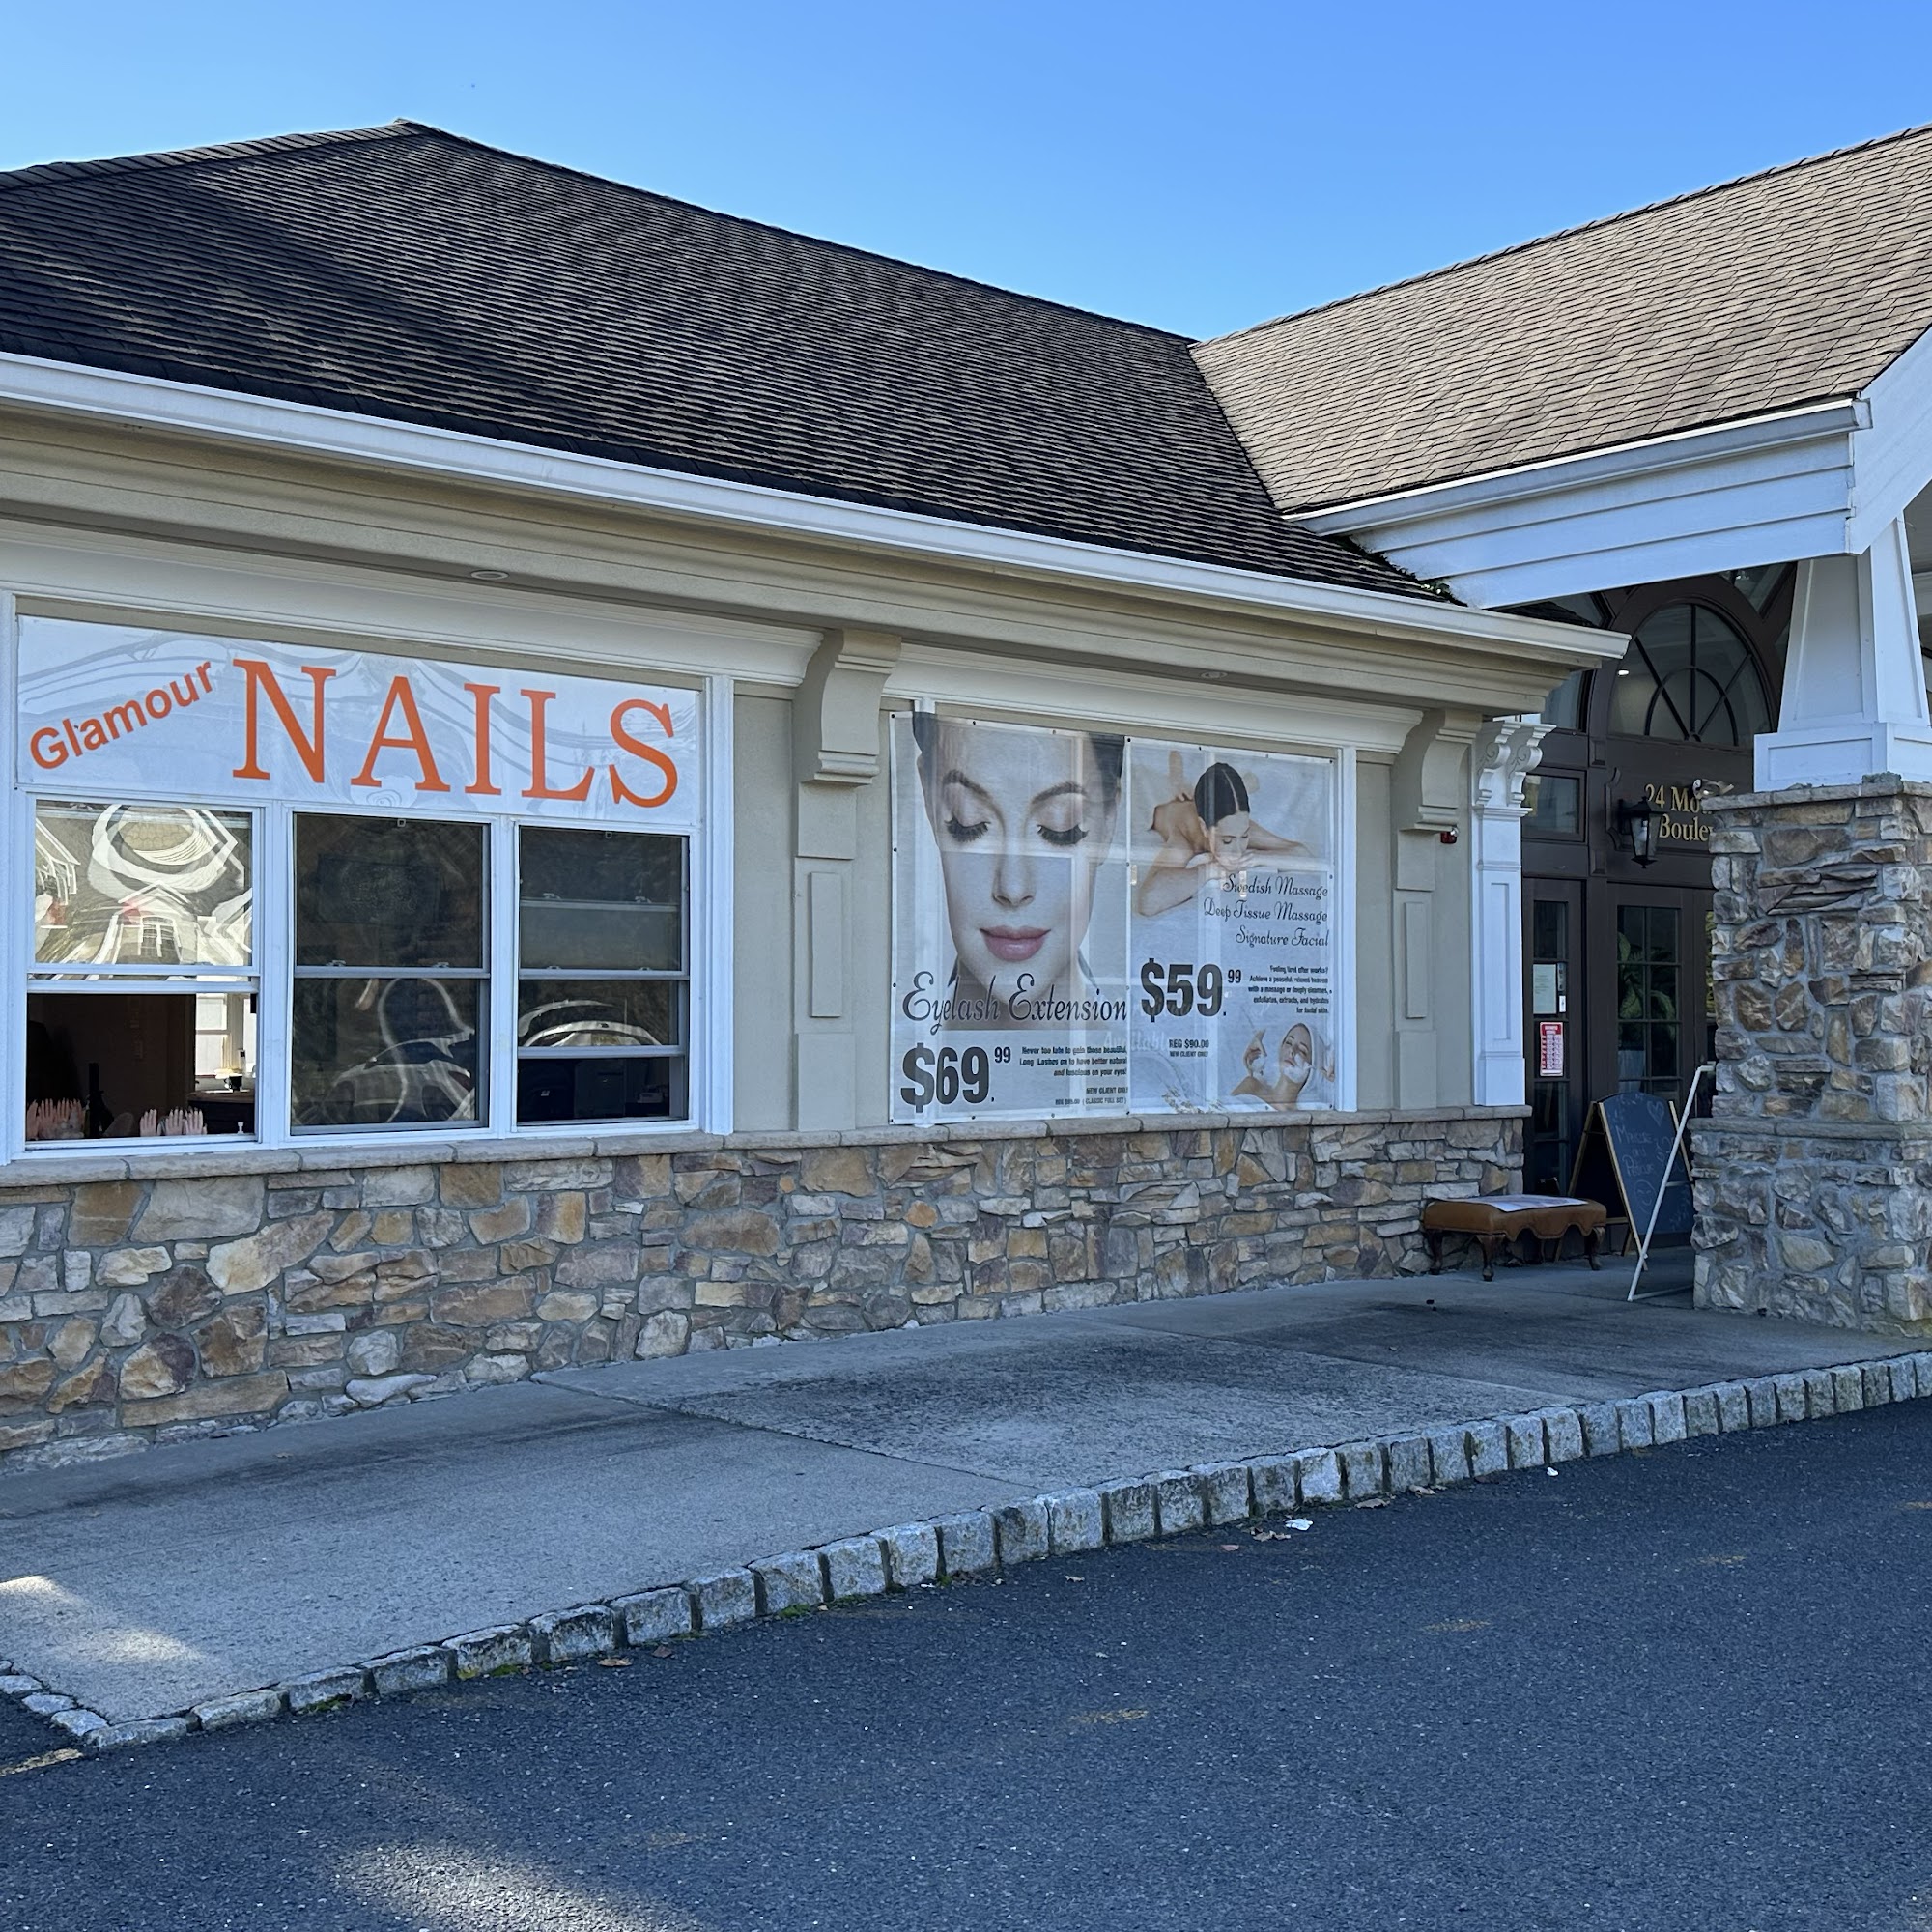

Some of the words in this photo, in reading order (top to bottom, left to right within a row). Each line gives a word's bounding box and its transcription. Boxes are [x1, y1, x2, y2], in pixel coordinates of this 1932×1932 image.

[30, 661, 213, 769] Glamour
[232, 658, 678, 809] NAILS
[1223, 873, 1272, 895] Swedish
[1275, 876, 1328, 900] Massage
[1204, 896, 1231, 922] Deep
[1234, 899, 1271, 920] Tissue
[1274, 901, 1328, 925] Massage
[1236, 924, 1289, 948] Signature
[1291, 927, 1330, 947] Facial
[902, 971, 1001, 1036] Eyelash
[1009, 973, 1127, 1022] Extension
[1169, 1039, 1183, 1049] REG
[1184, 1038, 1209, 1049] $90.00
[1019, 1058, 1035, 1066] Long
